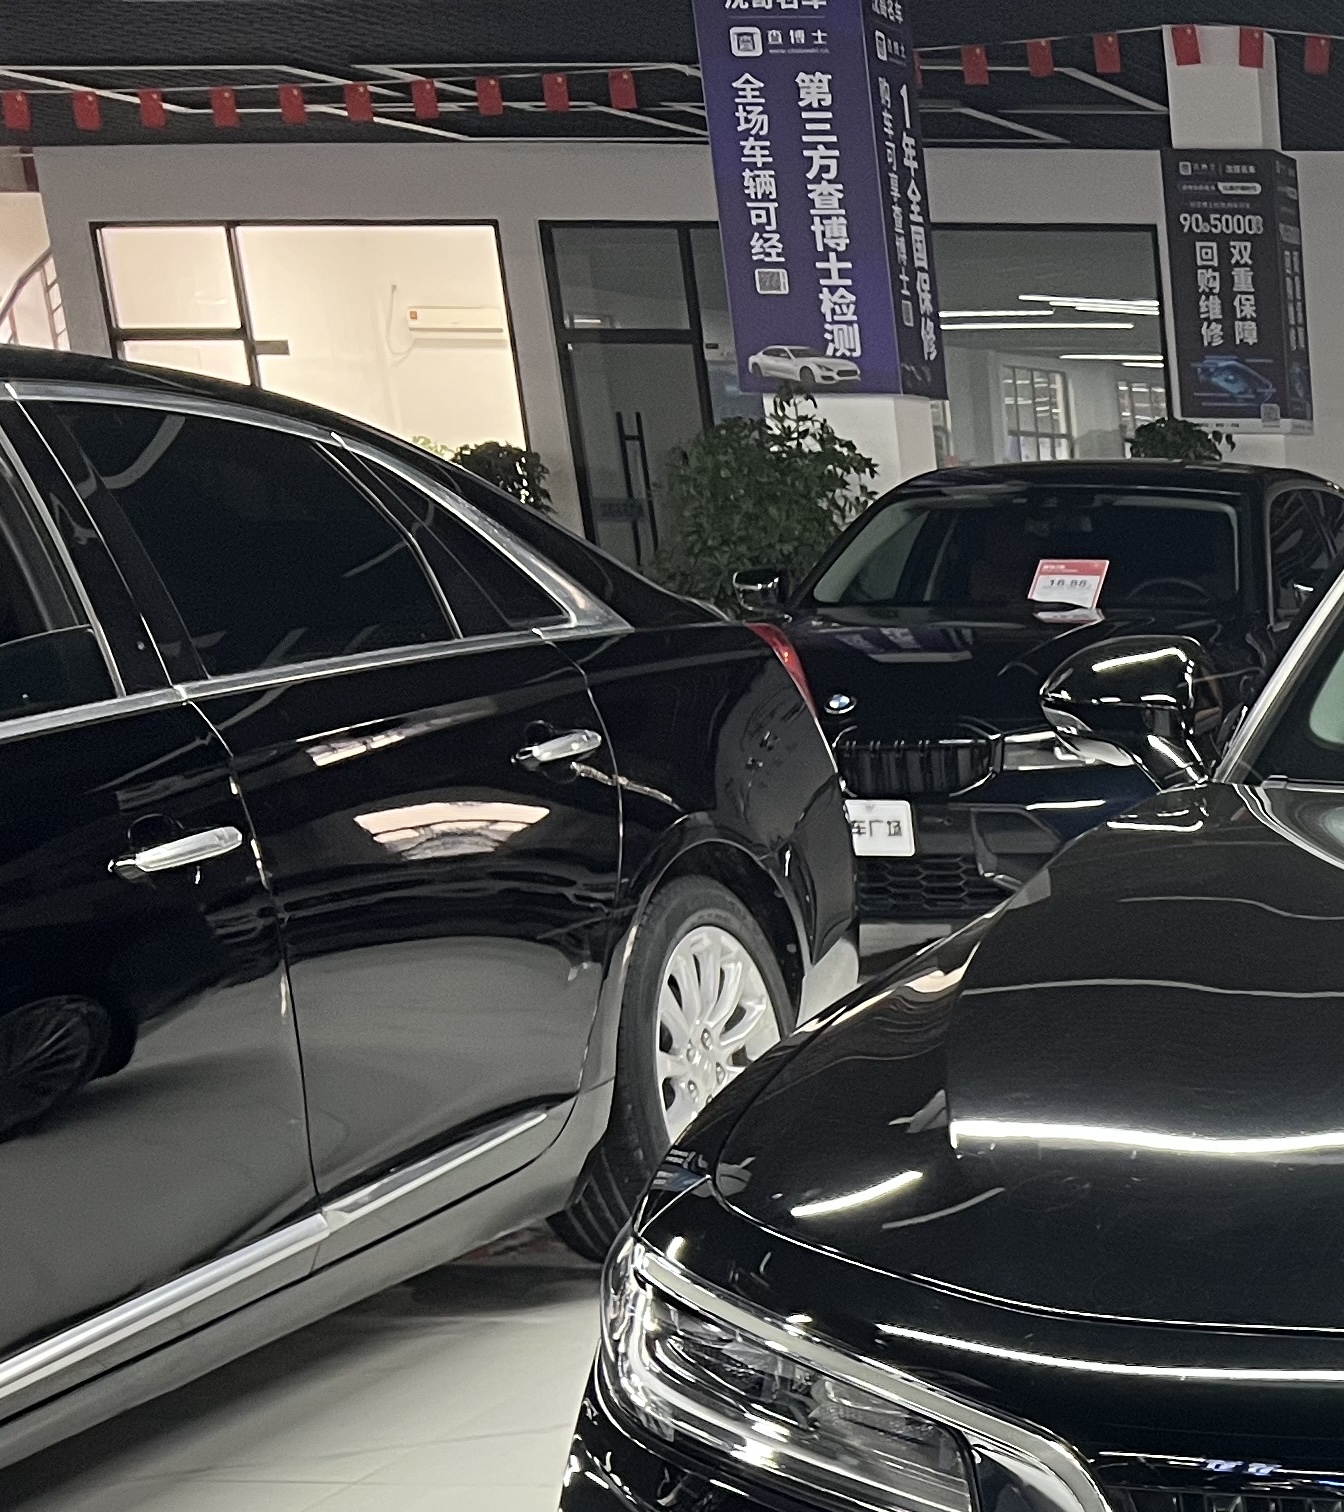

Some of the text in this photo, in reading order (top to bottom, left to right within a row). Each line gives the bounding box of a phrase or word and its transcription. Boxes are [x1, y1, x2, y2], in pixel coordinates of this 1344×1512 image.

[731, 72, 786, 262] 全场车辆可经
[795, 71, 862, 358] 第三方查博士检测
[900, 83, 938, 361] 1年全国保修
[1194, 240, 1224, 348] 回购维修
[1229, 240, 1259, 346] 双重保障
